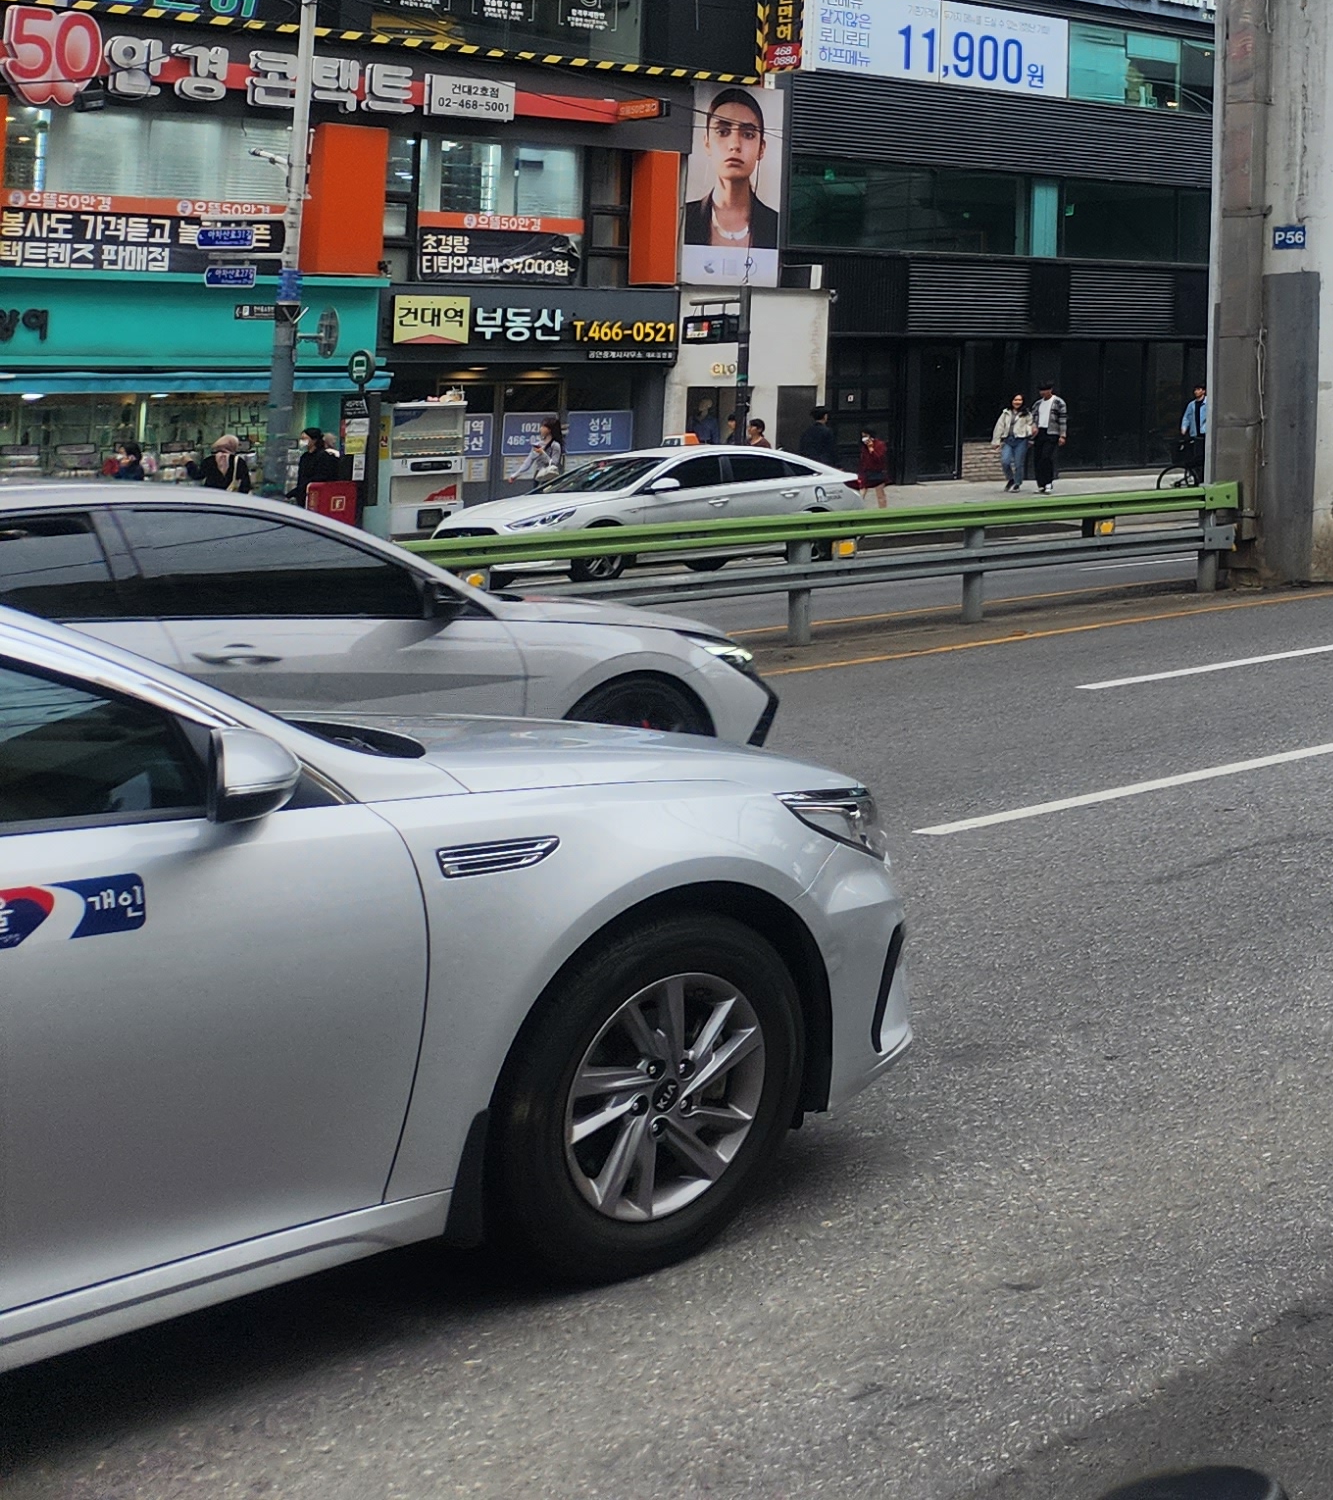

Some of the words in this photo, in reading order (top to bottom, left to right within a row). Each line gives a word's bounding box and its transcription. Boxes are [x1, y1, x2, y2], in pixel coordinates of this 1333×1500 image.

[11, 12, 101, 82] 50
[104, 35, 231, 101] 안경
[818, 46, 871, 68] 하프메뉴
[450, 83, 500, 99] 건대2호점
[437, 98, 511, 114] 02-468-5001
[26, 192, 112, 212] 으뜸50안경
[476, 214, 542, 232] 으뜸50안경
[421, 234, 470, 255] 초경량
[1275, 231, 1305, 245] P56
[102, 243, 171, 272] 판매점
[397, 305, 465, 329] 건대역
[474, 307, 564, 342] 부동산
[573, 320, 676, 343] T.466-0521
[588, 417, 613, 432] 성실
[587, 432, 612, 447] 중개
[87, 885, 144, 918] 개인
